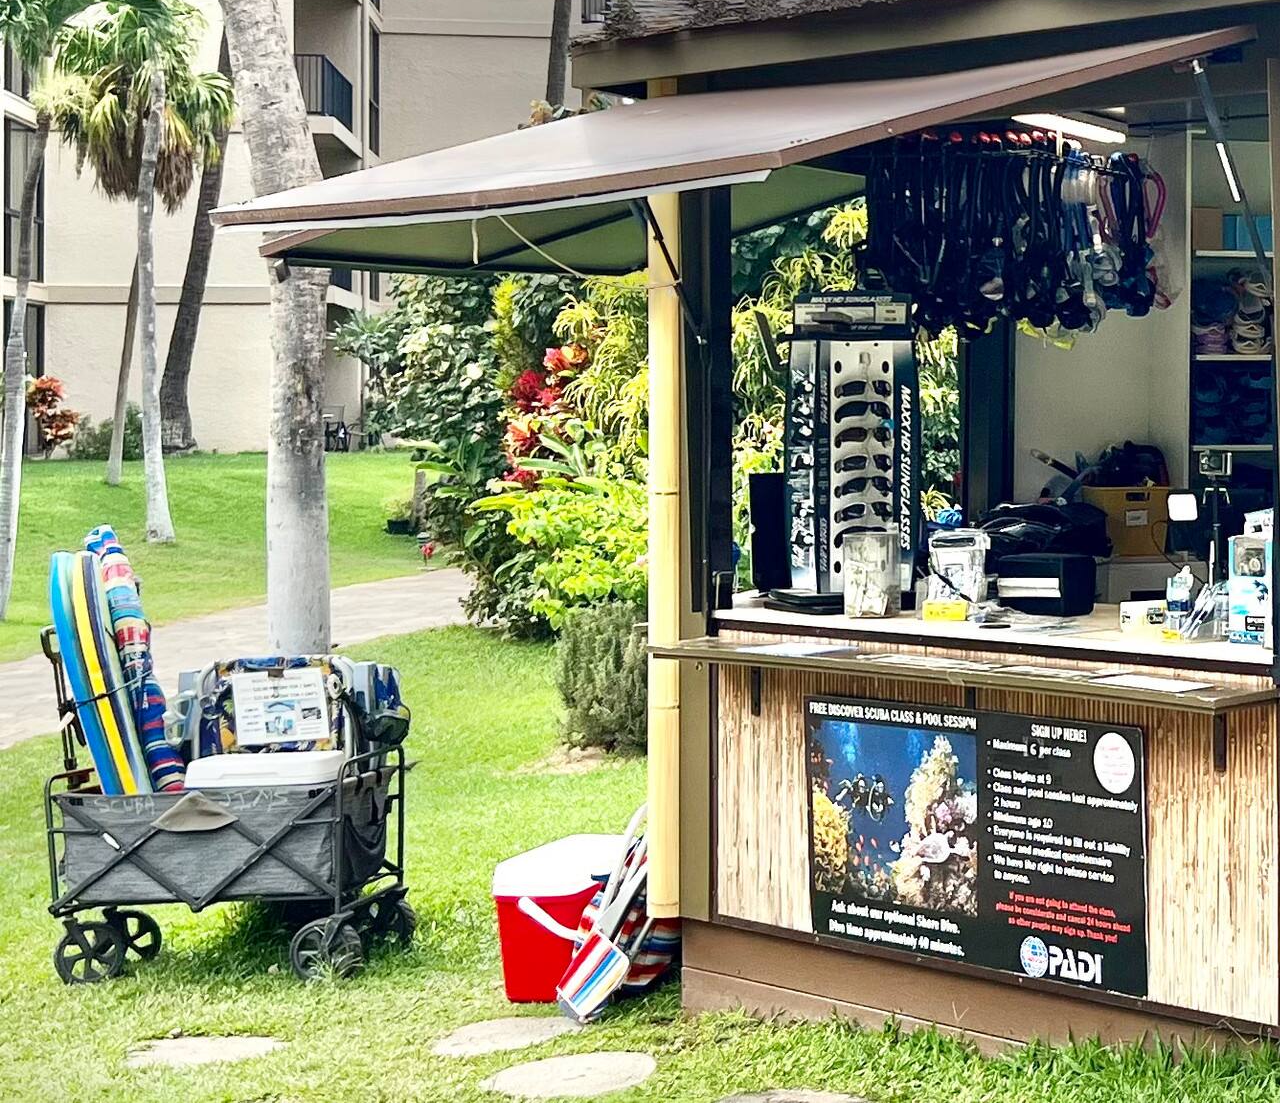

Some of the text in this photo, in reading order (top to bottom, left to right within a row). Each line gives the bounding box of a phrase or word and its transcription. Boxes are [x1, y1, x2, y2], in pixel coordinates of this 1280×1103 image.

[901, 384, 911, 550] MAXX HD SUNGLASSES
[809, 702, 827, 714] FREE
[828, 704, 864, 719] DISCOVER
[865, 707, 890, 721] SCUBA
[891, 710, 914, 724] CLASS
[916, 712, 921, 724] &
[923, 712, 942, 726] POOL
[1031, 724, 1087, 743] SIGN UP HERE!
[1029, 744, 1036, 755] 6
[1046, 774, 1052, 784] 9
[94, 797, 155, 815] SCUBA
[994, 796, 999, 807] 2
[831, 900, 846, 913] Ask
[847, 903, 869, 917] about
[870, 909, 883, 920] our
[884, 910, 915, 926] optional
[916, 915, 940, 931] Shore
[829, 919, 845, 933] Dive
[846, 923, 863, 936] time
[864, 928, 918, 950] approximately
[1049, 945, 1104, 984] PADI
